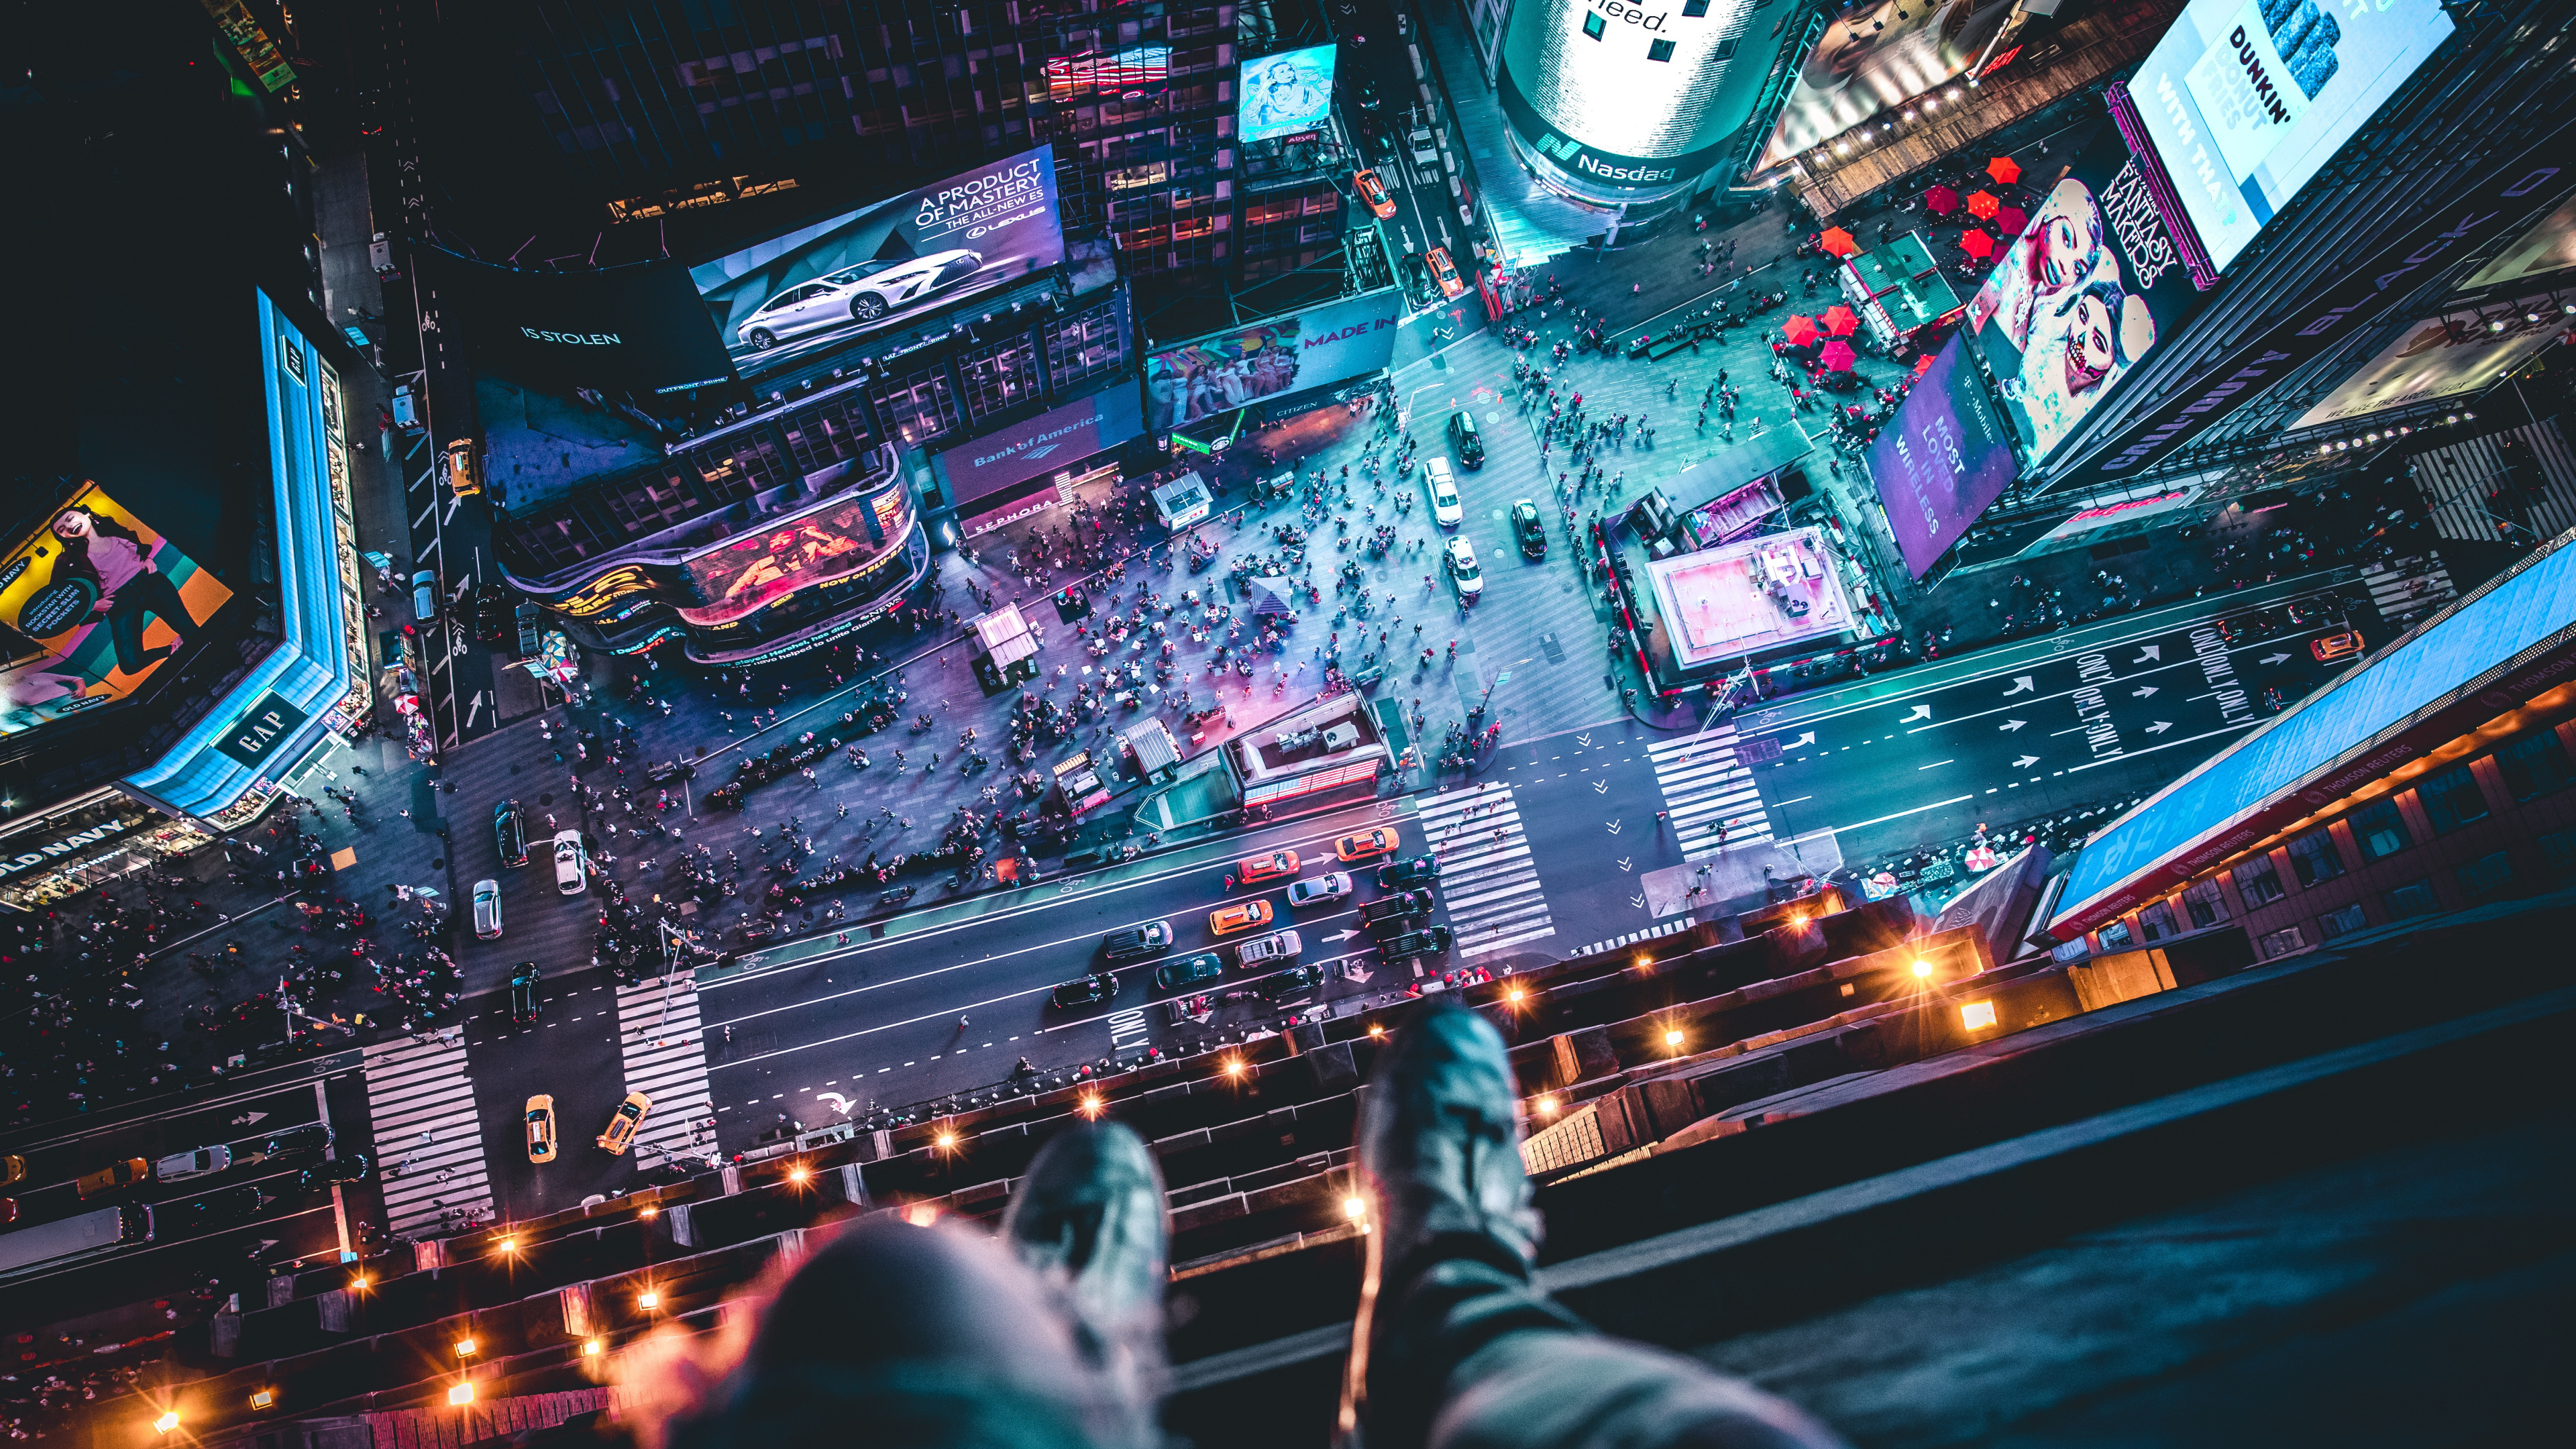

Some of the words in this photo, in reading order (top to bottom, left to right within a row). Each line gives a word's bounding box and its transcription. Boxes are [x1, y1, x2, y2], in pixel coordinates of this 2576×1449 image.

[2215, 43, 2267, 131] DONUT
[2229, 25, 2292, 125] DUNKIN'
[2157, 72, 2196, 146] WITH
[2202, 60, 2241, 131] FRIES
[1288, 134, 1316, 143] Absen
[920, 197, 935, 211] A
[938, 158, 1040, 205] PRODUCT
[1577, 153, 1676, 182] Nasdaq
[915, 207, 945, 226] OF
[949, 172, 1041, 215] MASTERY
[946, 217, 970, 229] THE
[973, 195, 1026, 221] ALL-NEW
[1029, 189, 1044, 201] ES
[988, 206, 1046, 231] LEXUS
[2099, 178, 2158, 289] MAKERS
[2114, 160, 2178, 277] FANTASY
[2295, 209, 2500, 336] BLACK
[521, 326, 540, 339] IS
[540, 331, 621, 345] STOLEN
[1305, 322, 1368, 350] MADE
[1375, 315, 1396, 331] IN
[290, 346, 301, 374] GAP
[657, 382, 699, 394] OUTFRONT
[704, 377, 727, 386] PRIME
[2325, 407, 2345, 419] WE
[2345, 401, 2375, 415] ARE
[2375, 396, 2399, 410] THE
[2395, 385, 2440, 407] ARCTIC
[2440, 380, 2470, 395] FOX
[1277, 401, 1318, 417] CITIZEN
[2101, 419, 2195, 470] CALL
[2180, 350, 2292, 413] DUTY
[975, 447, 1016, 468] Bank
[1018, 437, 1036, 451] of
[1037, 414, 1104, 444] America
[1922, 425, 1954, 493] LOVED
[1935, 415, 1965, 474] MOST
[1921, 460, 1935, 484] IN
[975, 500, 1053, 533] SEPHORA
[5, 560, 26, 582] NAVY
[819, 576, 850, 589] NOW
[852, 570, 867, 580] ON
[25, 598, 58, 629] ROCKSTAR
[56, 584, 74, 600] WITH
[29, 589, 59, 616] introducing
[32, 588, 80, 633] SECRET-SLIM
[46, 599, 80, 630] POCKETS
[869, 596, 902, 616] NEWS
[647, 626, 671, 643] actor
[712, 621, 739, 631] AND
[734, 654, 768, 667] played
[811, 632, 830, 643] has
[830, 621, 852, 635] died
[779, 645, 813, 659] helped
[813, 641, 825, 649] to
[825, 630, 851, 643] unite
[851, 615, 881, 632] Giants
[2189, 627, 2229, 656] ONLY
[2076, 654, 2115, 683] ONLY
[2200, 656, 2239, 689] ONLY
[2508, 658, 2575, 692] THOMSON
[62, 703, 81, 713] OLD
[80, 695, 106, 707] NAVY
[2216, 689, 2255, 724] ONLY
[238, 711, 285, 753] GAP
[2324, 763, 2368, 794] THOMSON
[2367, 744, 2414, 775] REUTERS
[41, 818, 126, 857] NAVY
[2187, 845, 2221, 868] THOMSON
[2220, 829, 2256, 853] REUTERS
[65, 861, 89, 875] OLD
[87, 851, 122, 867] NAVY
[2082, 908, 2108, 931] THOMSON
[2107, 894, 2136, 916] REUTERS
[1108, 1010, 1150, 1051] ONLY
